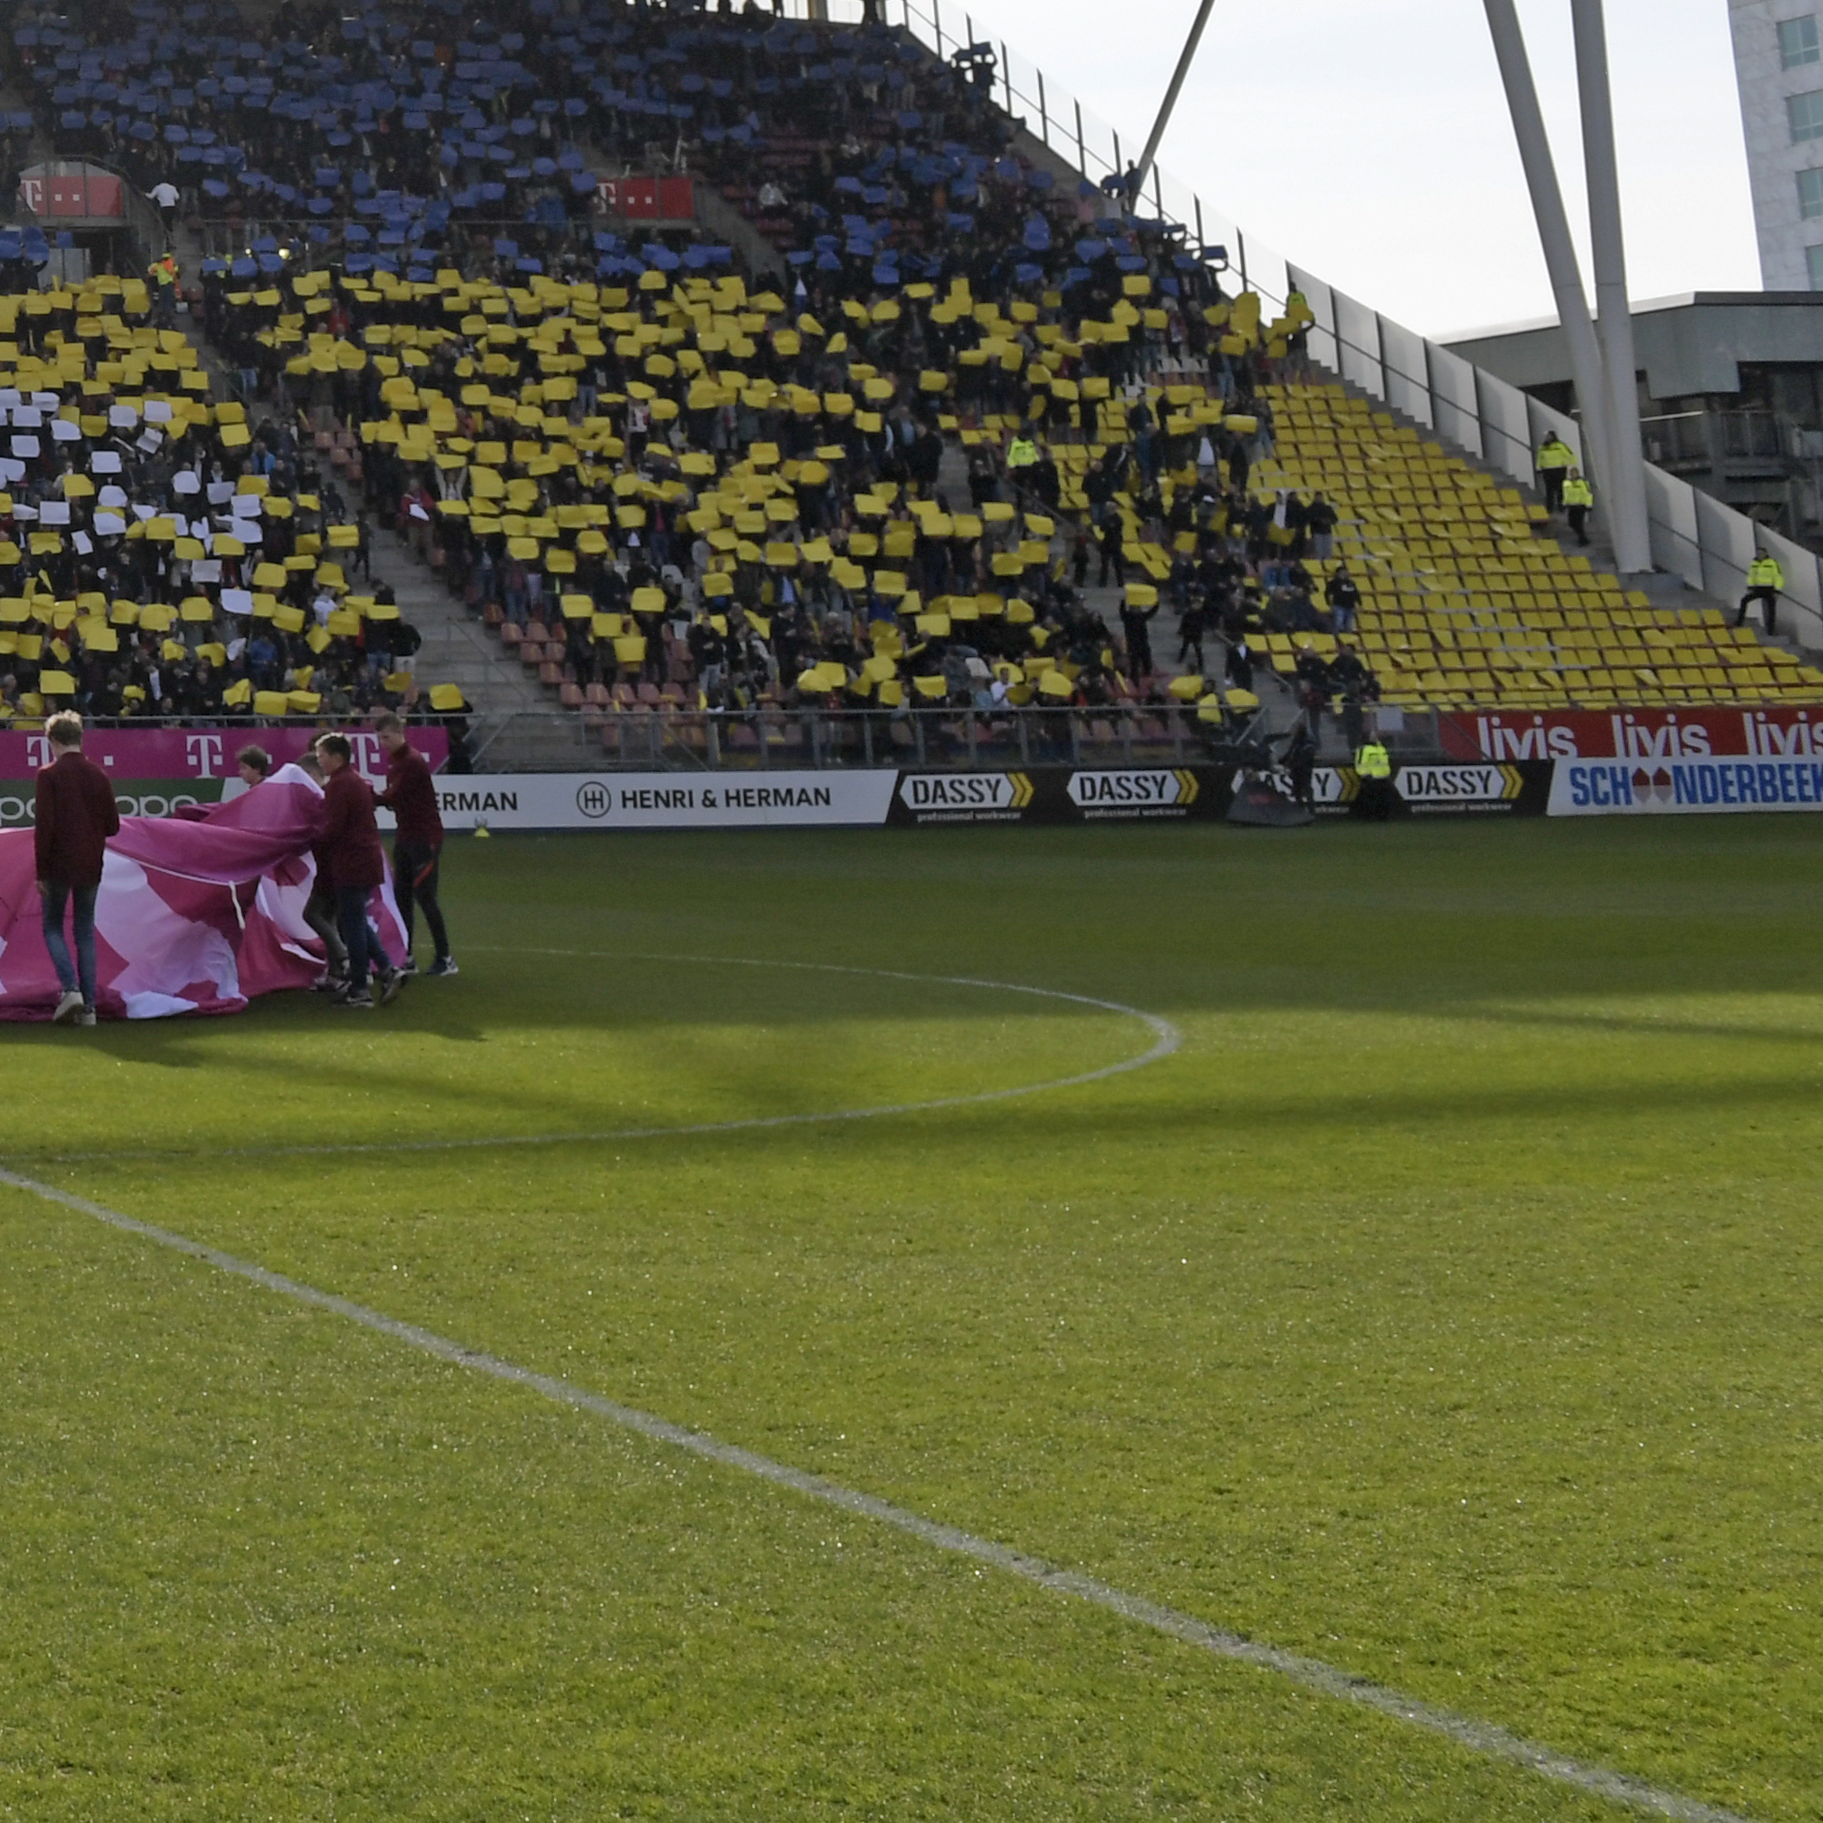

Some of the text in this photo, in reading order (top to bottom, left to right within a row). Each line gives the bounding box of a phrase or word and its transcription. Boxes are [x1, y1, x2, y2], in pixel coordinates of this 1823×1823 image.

[1477, 715, 1578, 760] livis
[1611, 713, 1712, 757] livis
[912, 778, 1001, 805] DASSY
[1079, 774, 1169, 801] DASSY
[1406, 769, 1494, 796] DASSY
[434, 791, 518, 812] ERMAN
[620, 789, 694, 809] HENRI
[701, 788, 718, 809] &
[725, 786, 831, 808] HERMAN
